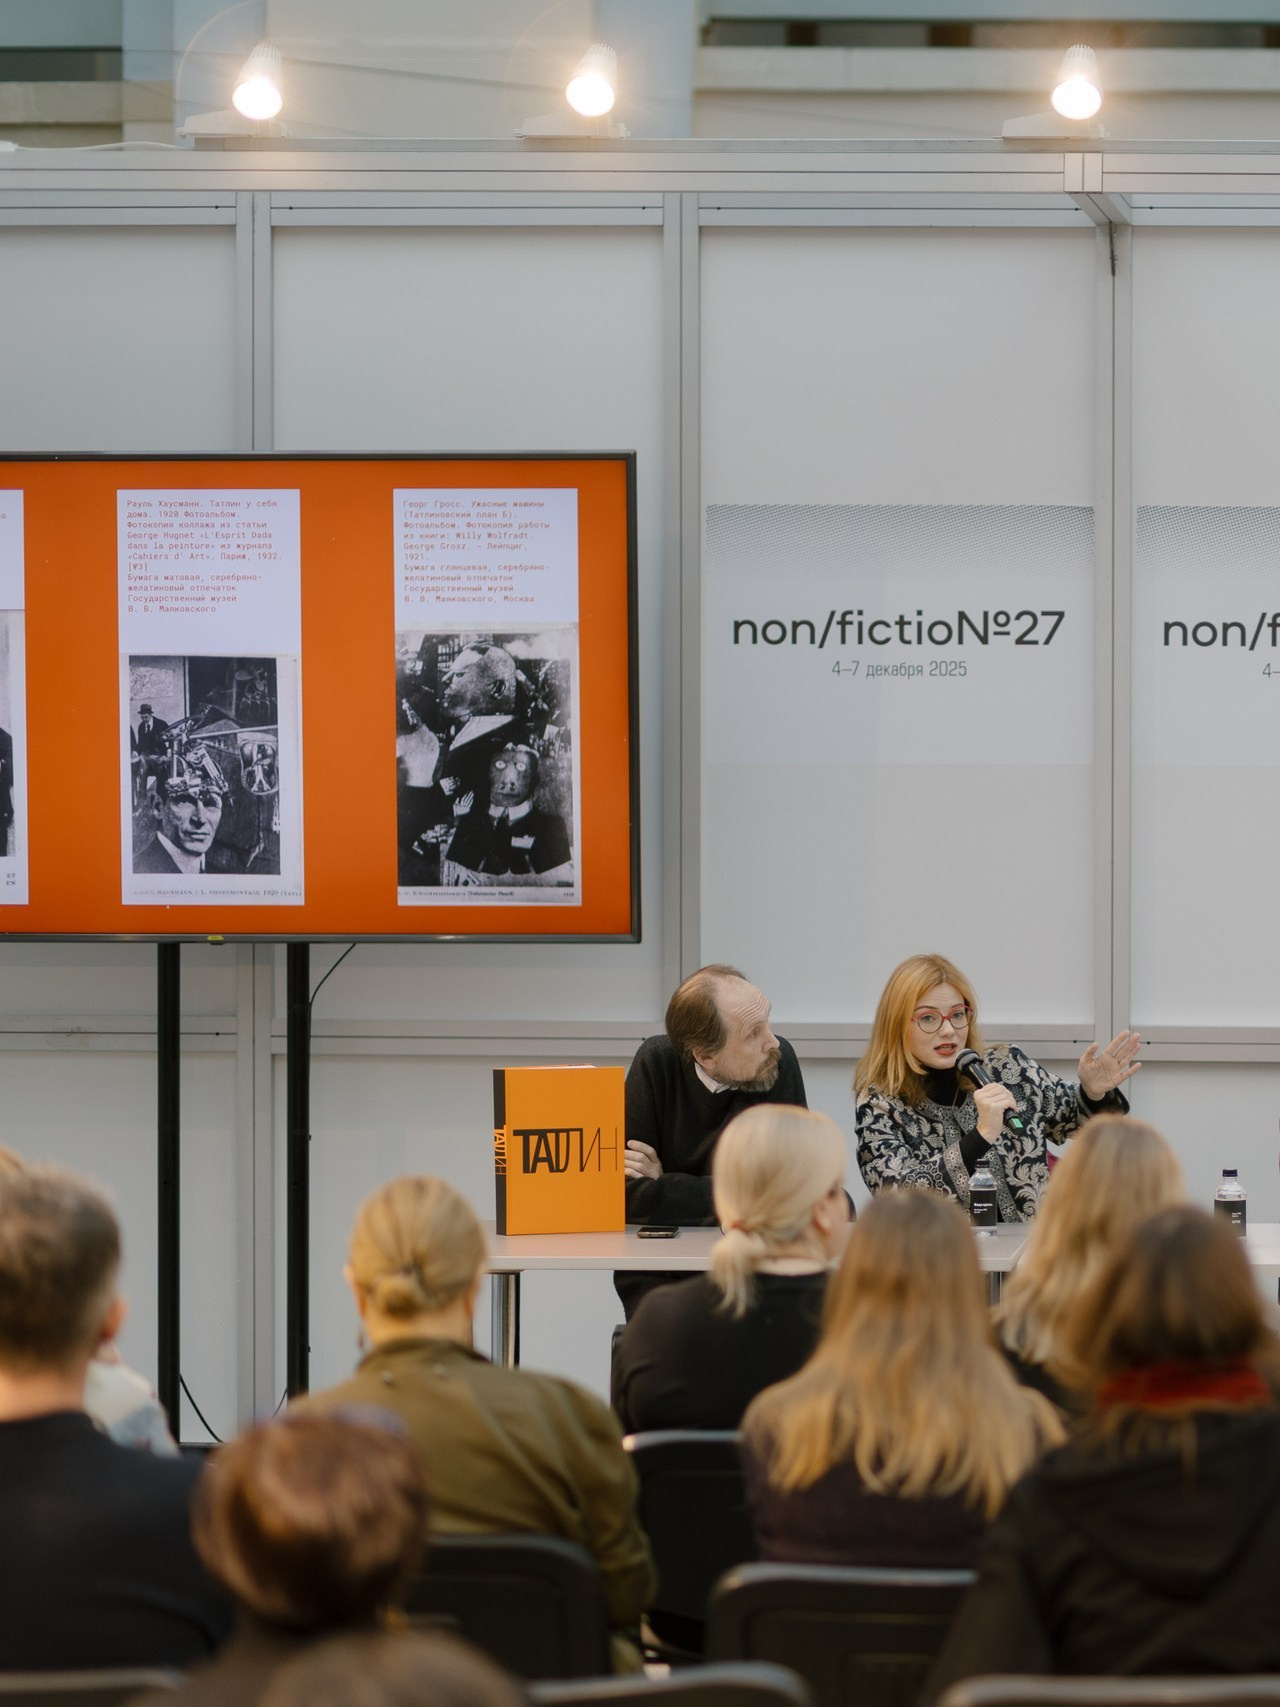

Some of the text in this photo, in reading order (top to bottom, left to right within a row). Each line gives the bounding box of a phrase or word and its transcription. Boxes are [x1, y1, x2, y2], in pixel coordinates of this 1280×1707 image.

[127, 500, 152, 509] Рауль
[404, 500, 429, 509] Георг
[404, 510, 471, 519] (Татлиновский
[128, 521, 173, 530] Фотокопия
[467, 521, 513, 530] Фотокопия
[519, 521, 549, 530] работы
[128, 532, 158, 540] George
[164, 532, 194, 540] Hugnet
[456, 532, 481, 540] Willy
[237, 543, 272, 551] журнала
[404, 542, 435, 551] George
[404, 564, 435, 572] Бумага
[128, 574, 159, 582] Бумага
[405, 585, 513, 593] Государственный музей
[129, 595, 237, 603] Государственный музей
[866, 662, 923, 679] декабря
[929, 661, 967, 676] 2025
